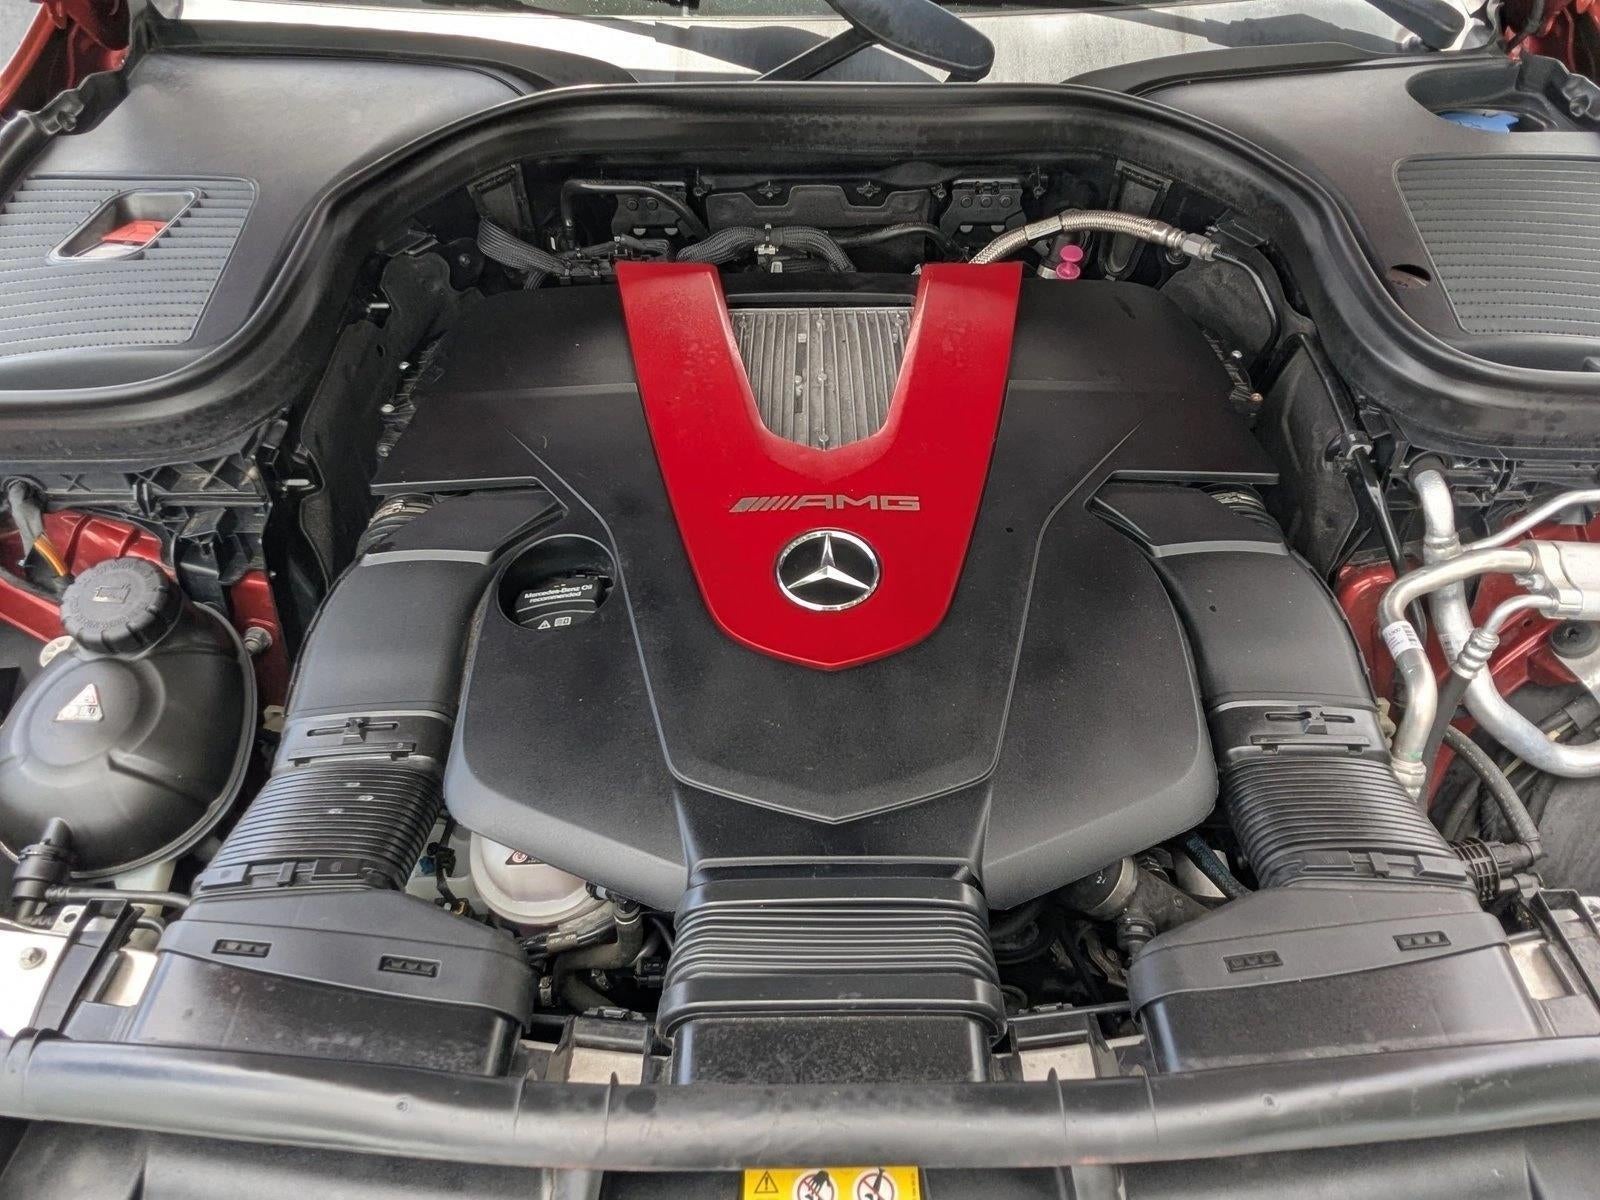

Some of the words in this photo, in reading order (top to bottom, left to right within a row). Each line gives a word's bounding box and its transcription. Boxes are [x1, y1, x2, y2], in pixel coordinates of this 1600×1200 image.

[790, 495, 920, 511] AMG
[524, 586, 580, 599] Mercedes-Benz
[529, 591, 582, 603] recommended
